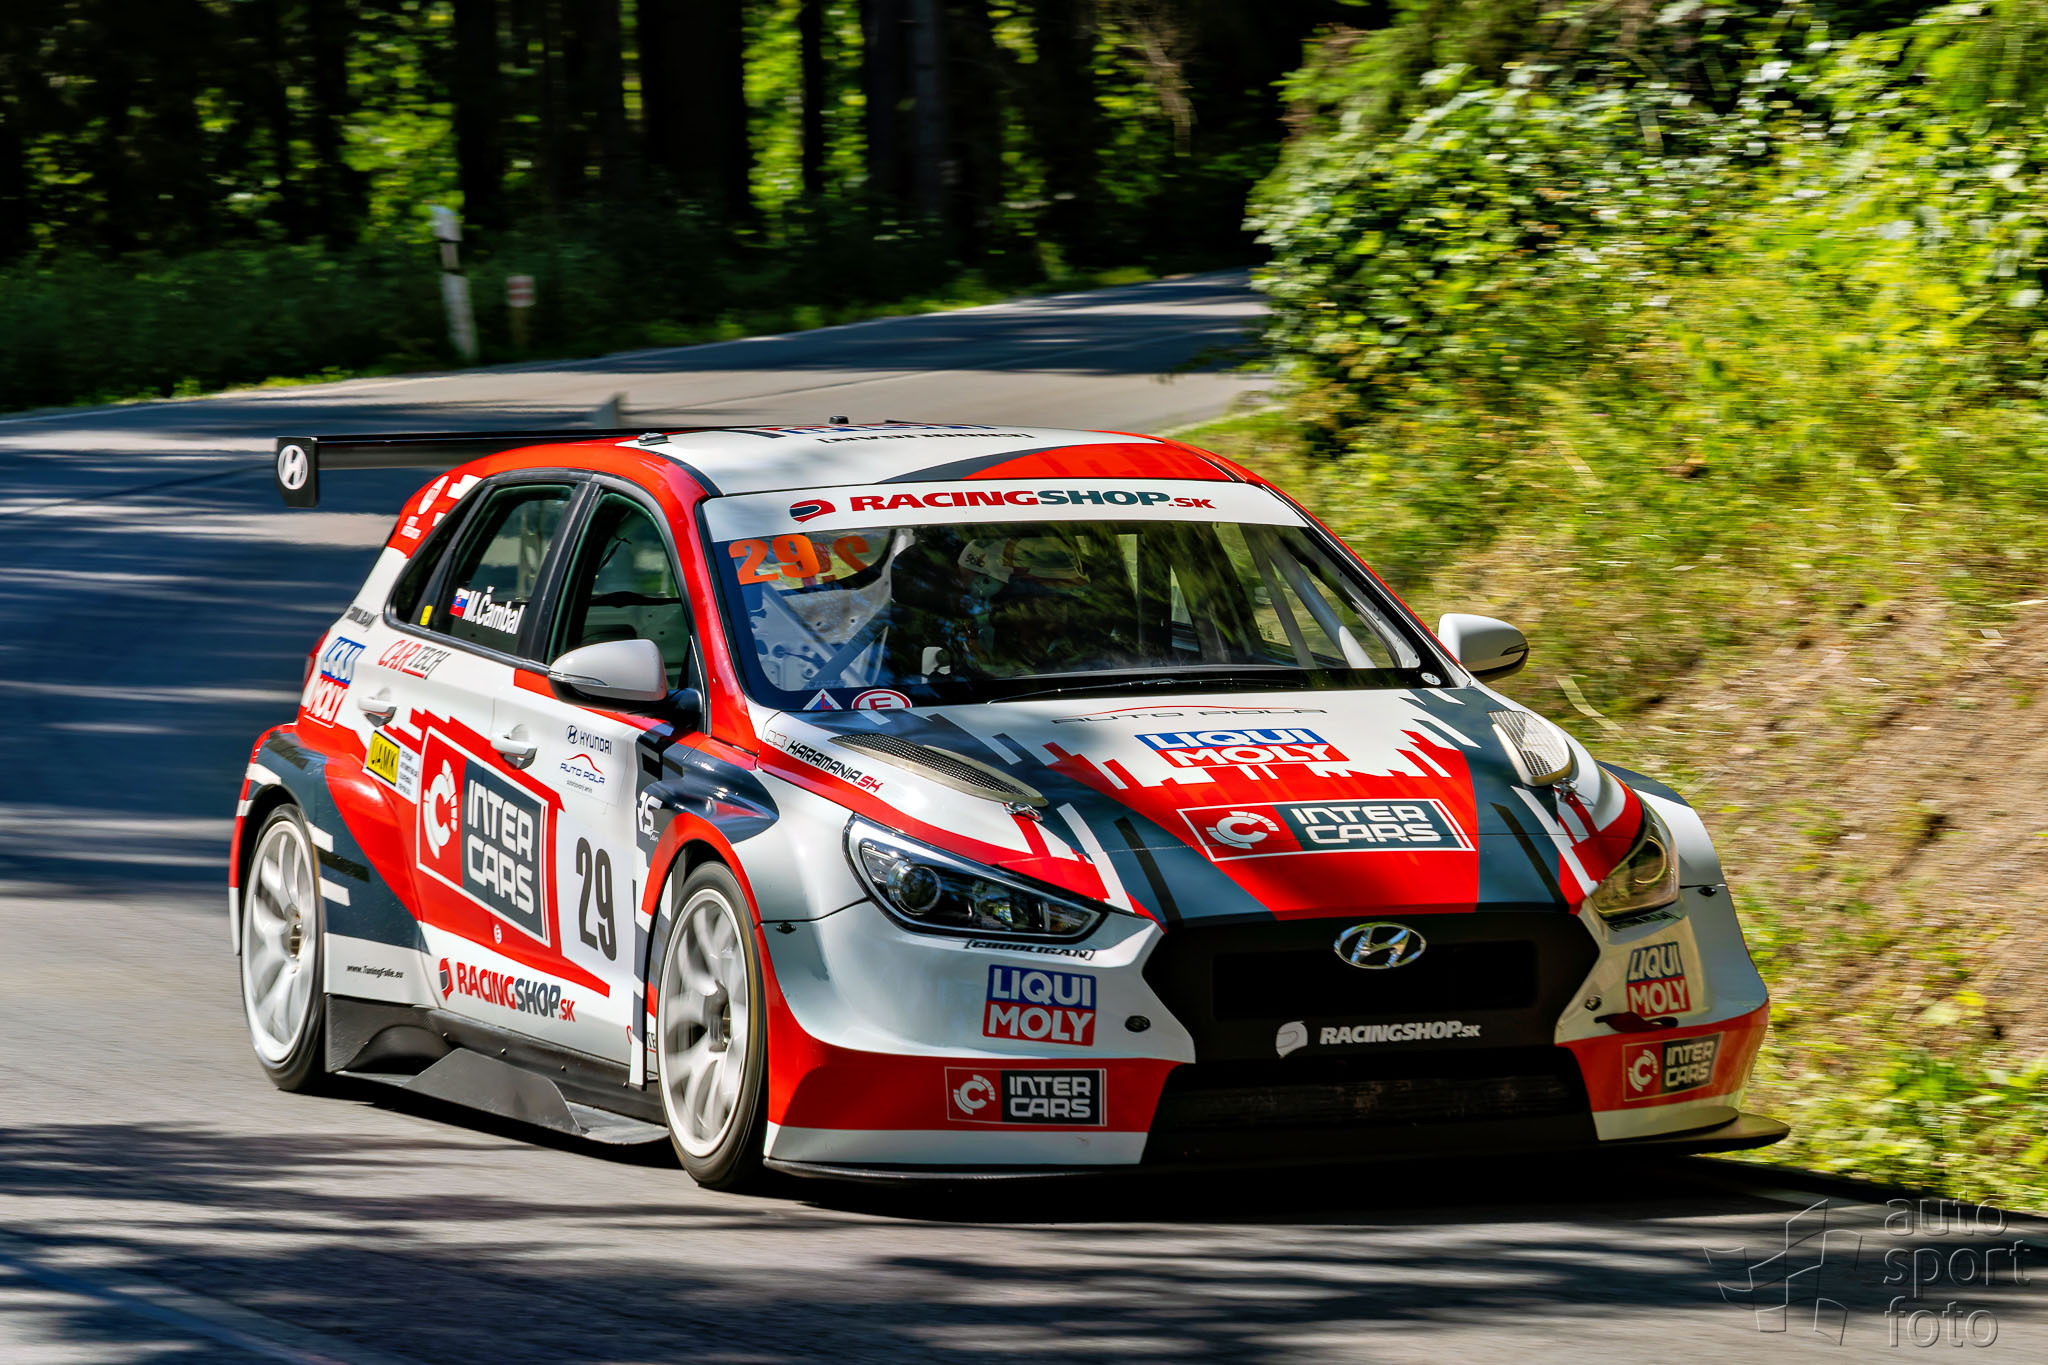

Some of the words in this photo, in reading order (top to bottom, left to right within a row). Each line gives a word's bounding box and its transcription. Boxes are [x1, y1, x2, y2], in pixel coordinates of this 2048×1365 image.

[728, 534, 820, 585] 29
[580, 730, 613, 755] HYUNDAI
[1144, 729, 1318, 749] LIQUI
[1166, 744, 1331, 766] MOLY
[560, 762, 582, 776] AUTO
[583, 771, 605, 784] POLA
[467, 779, 534, 862] INTER
[1290, 805, 1430, 825] INTER
[1305, 823, 1441, 843] CARS
[467, 834, 534, 914] CARS
[576, 837, 617, 961] 29
[1628, 944, 1683, 981] LIQUI
[992, 968, 1091, 1006] LIQUI
[1629, 979, 1687, 1014] MOLY
[988, 1004, 1094, 1042] MOLY
[1666, 1041, 1714, 1066] INTER
[1009, 1075, 1091, 1097] INTER
[1665, 1061, 1710, 1087] CARS
[1009, 1097, 1091, 1118] CARS
